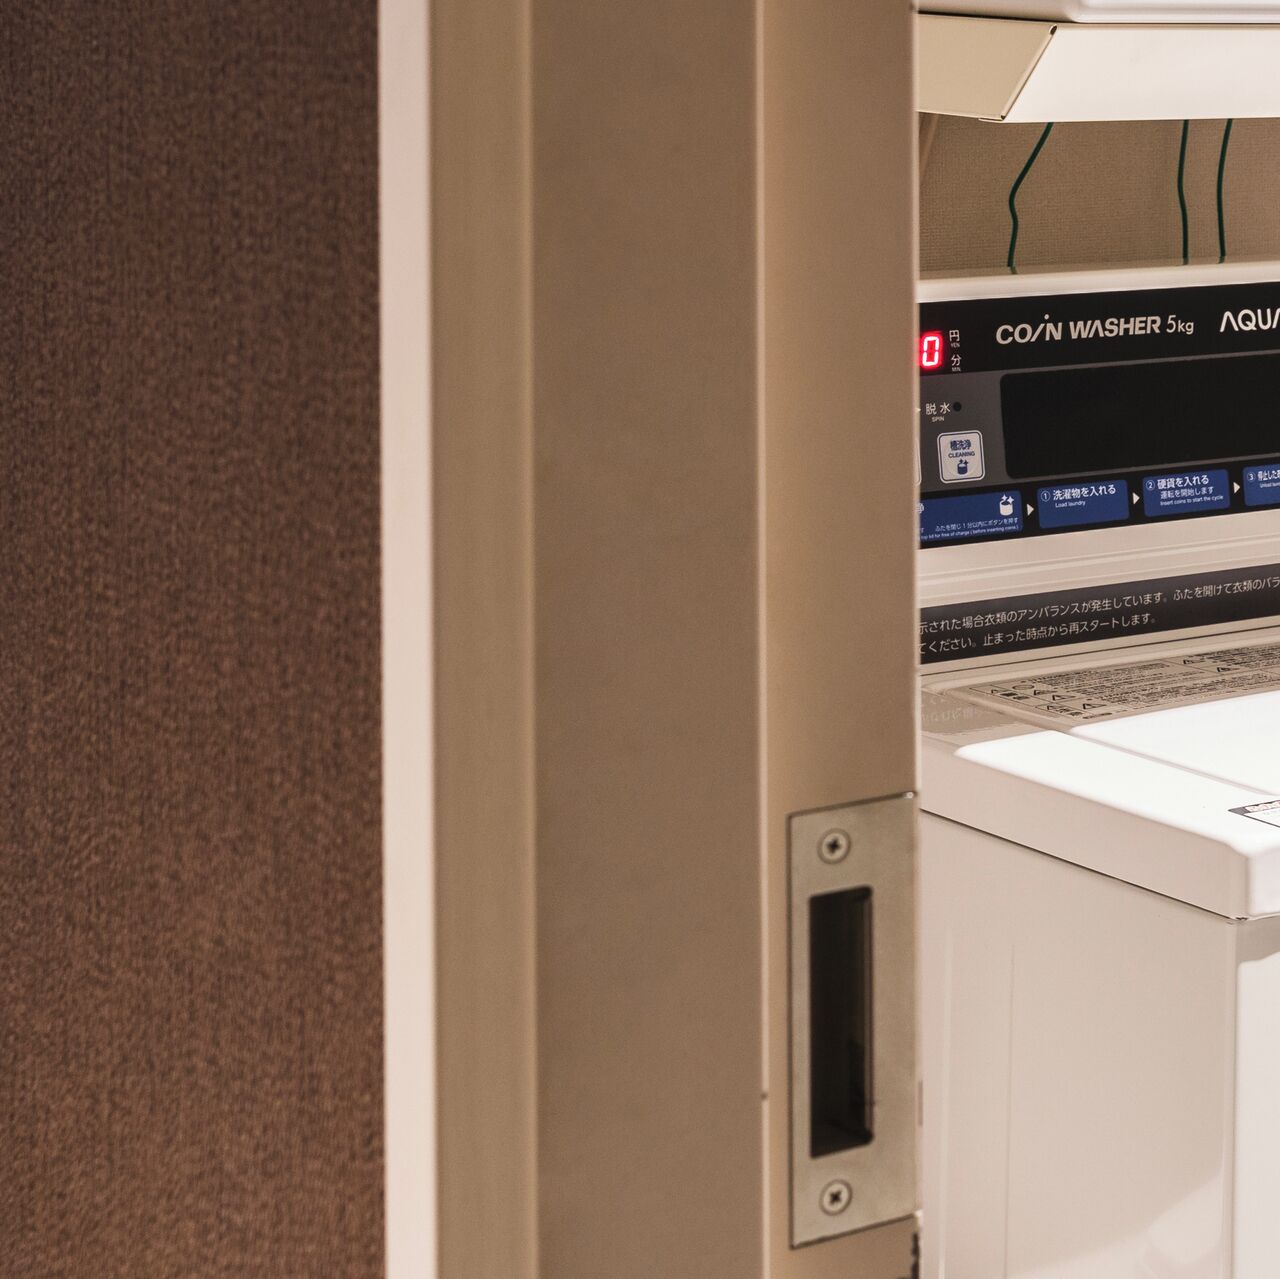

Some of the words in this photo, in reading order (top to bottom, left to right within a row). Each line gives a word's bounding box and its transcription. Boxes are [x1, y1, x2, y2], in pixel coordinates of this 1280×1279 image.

[1069, 315, 1161, 340] WASHER
[1166, 314, 1194, 335] 5kg
[949, 330, 959, 342] 円
[951, 354, 962, 366] 分
[1157, 475, 1209, 489] 硬貨を入れる
[1053, 484, 1116, 501] 洗濯物を入れる
[1160, 487, 1214, 500] 運転を開始します
